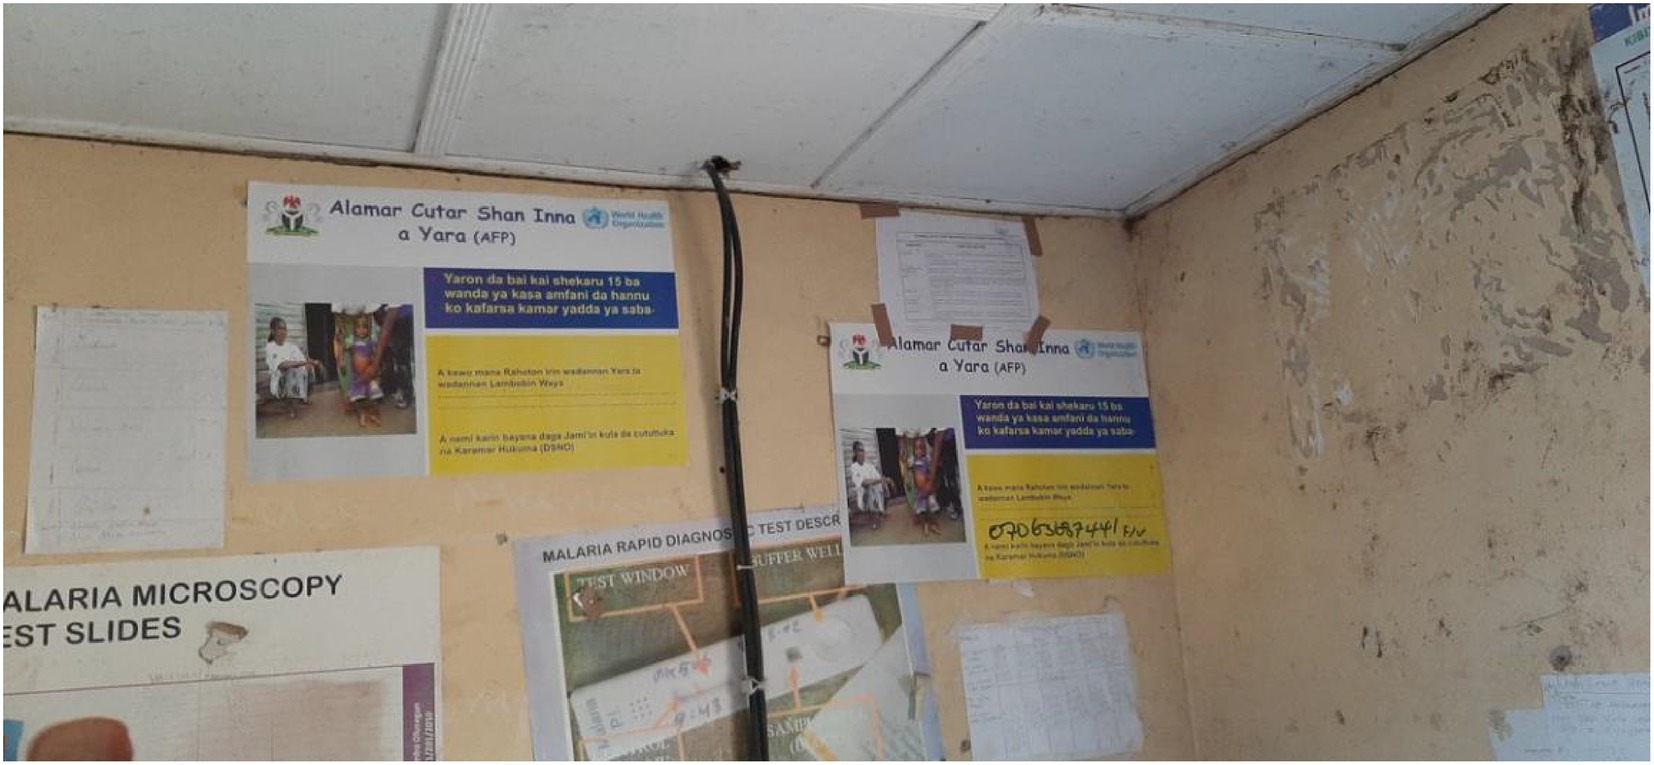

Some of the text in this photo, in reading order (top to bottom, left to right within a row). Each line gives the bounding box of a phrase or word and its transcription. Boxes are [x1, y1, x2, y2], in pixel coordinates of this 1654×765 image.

[330, 200, 576, 225] Alamar Cutar Shan Inna
[398, 226, 516, 246] a Yara (AFP)
[443, 273, 640, 287] Yaron da bai kai shekaru 15 ba
[444, 289, 650, 302] wanda ya kasa amfani da hannu
[444, 303, 462, 314] ko
[466, 303, 515, 314] kafarsa
[518, 303, 559, 314] kamar
[562, 304, 601, 317] yadda
[604, 306, 619, 317] ya
[888, 336, 941, 351] Alamar
[948, 338, 989, 352] Cutar
[1038, 340, 1070, 355] Inna
[939, 359, 1026, 375] a Yara (AFP)
[1007, 401, 1019, 410] da
[543, 543, 612, 563] MALARIA
[616, 536, 662, 554] RAPID
[759, 520, 792, 535] TEST
[577, 563, 691, 588] TEST WINDOW
[132, 575, 343, 606] MICROSCOPY
[66, 616, 182, 645] SLIDES
